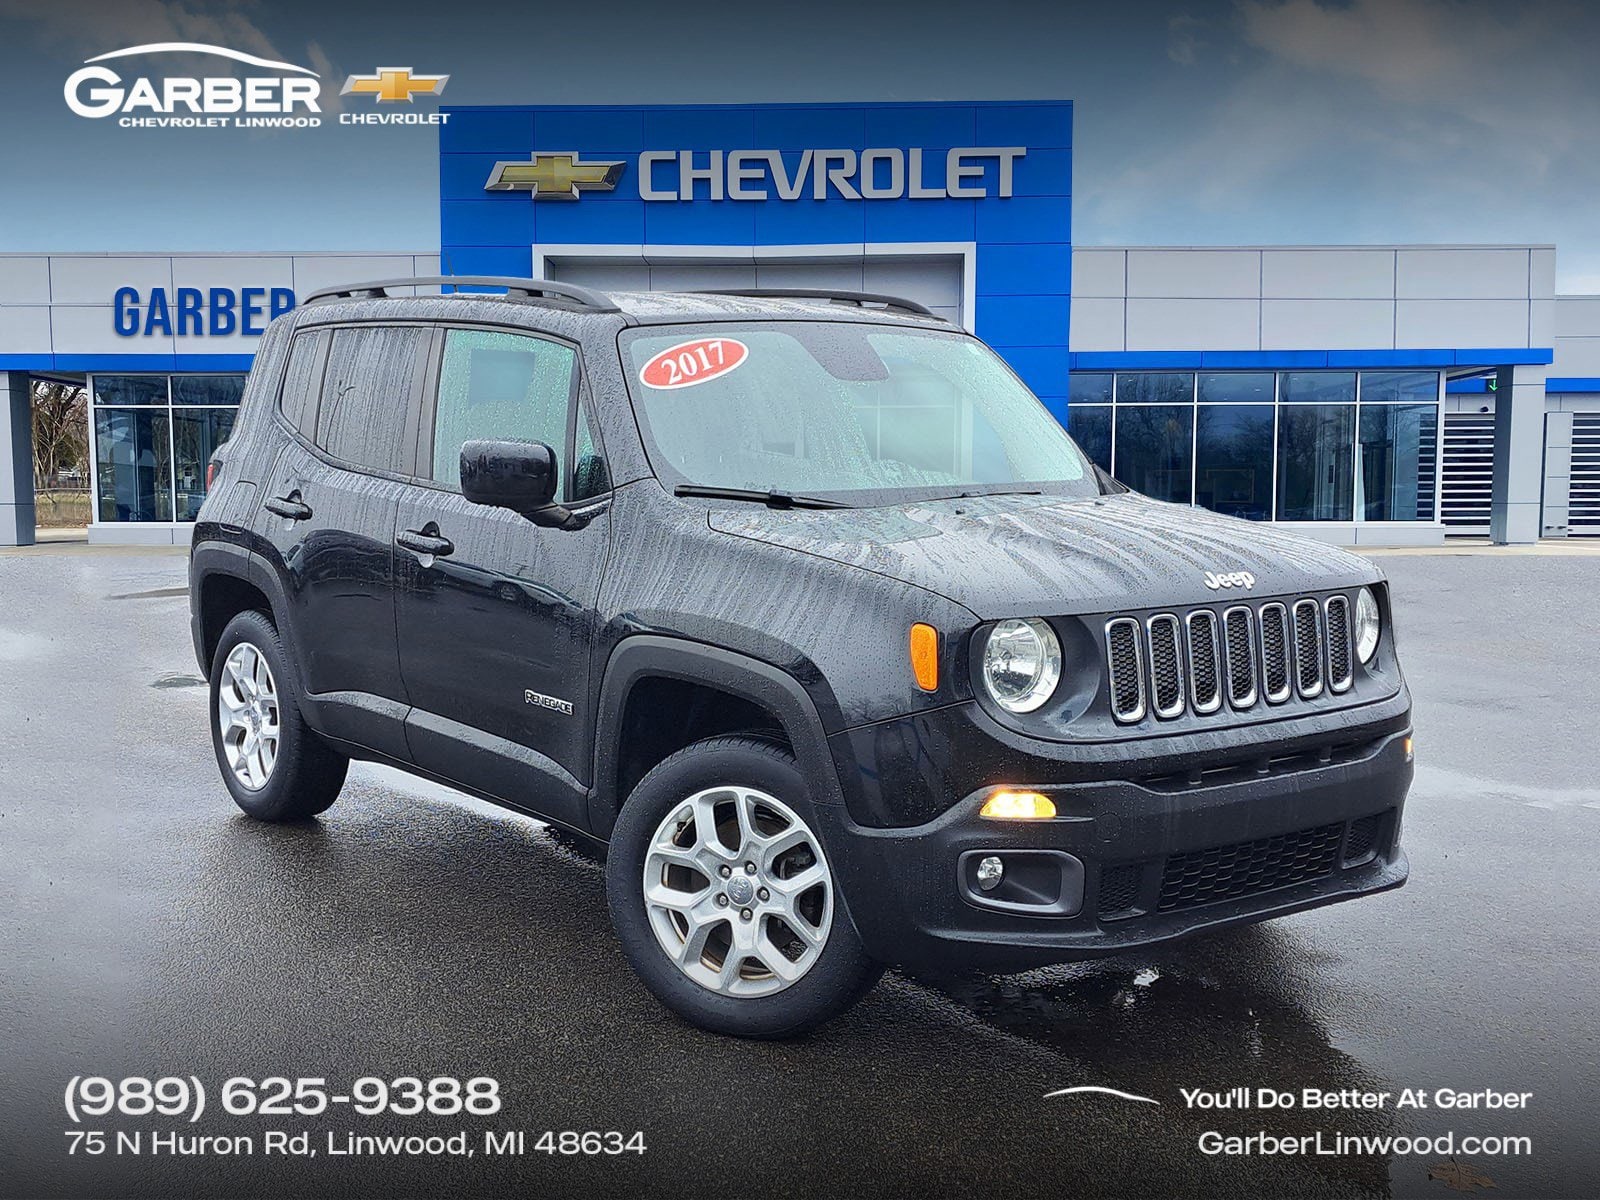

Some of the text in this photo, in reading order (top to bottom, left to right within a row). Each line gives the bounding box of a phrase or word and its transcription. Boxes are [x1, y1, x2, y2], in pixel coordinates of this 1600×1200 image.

[637, 146, 1027, 201] CHEVROLET
[660, 340, 724, 385] 2017
[1203, 571, 1256, 590] Jeep
[525, 689, 573, 716] RENEGADE
